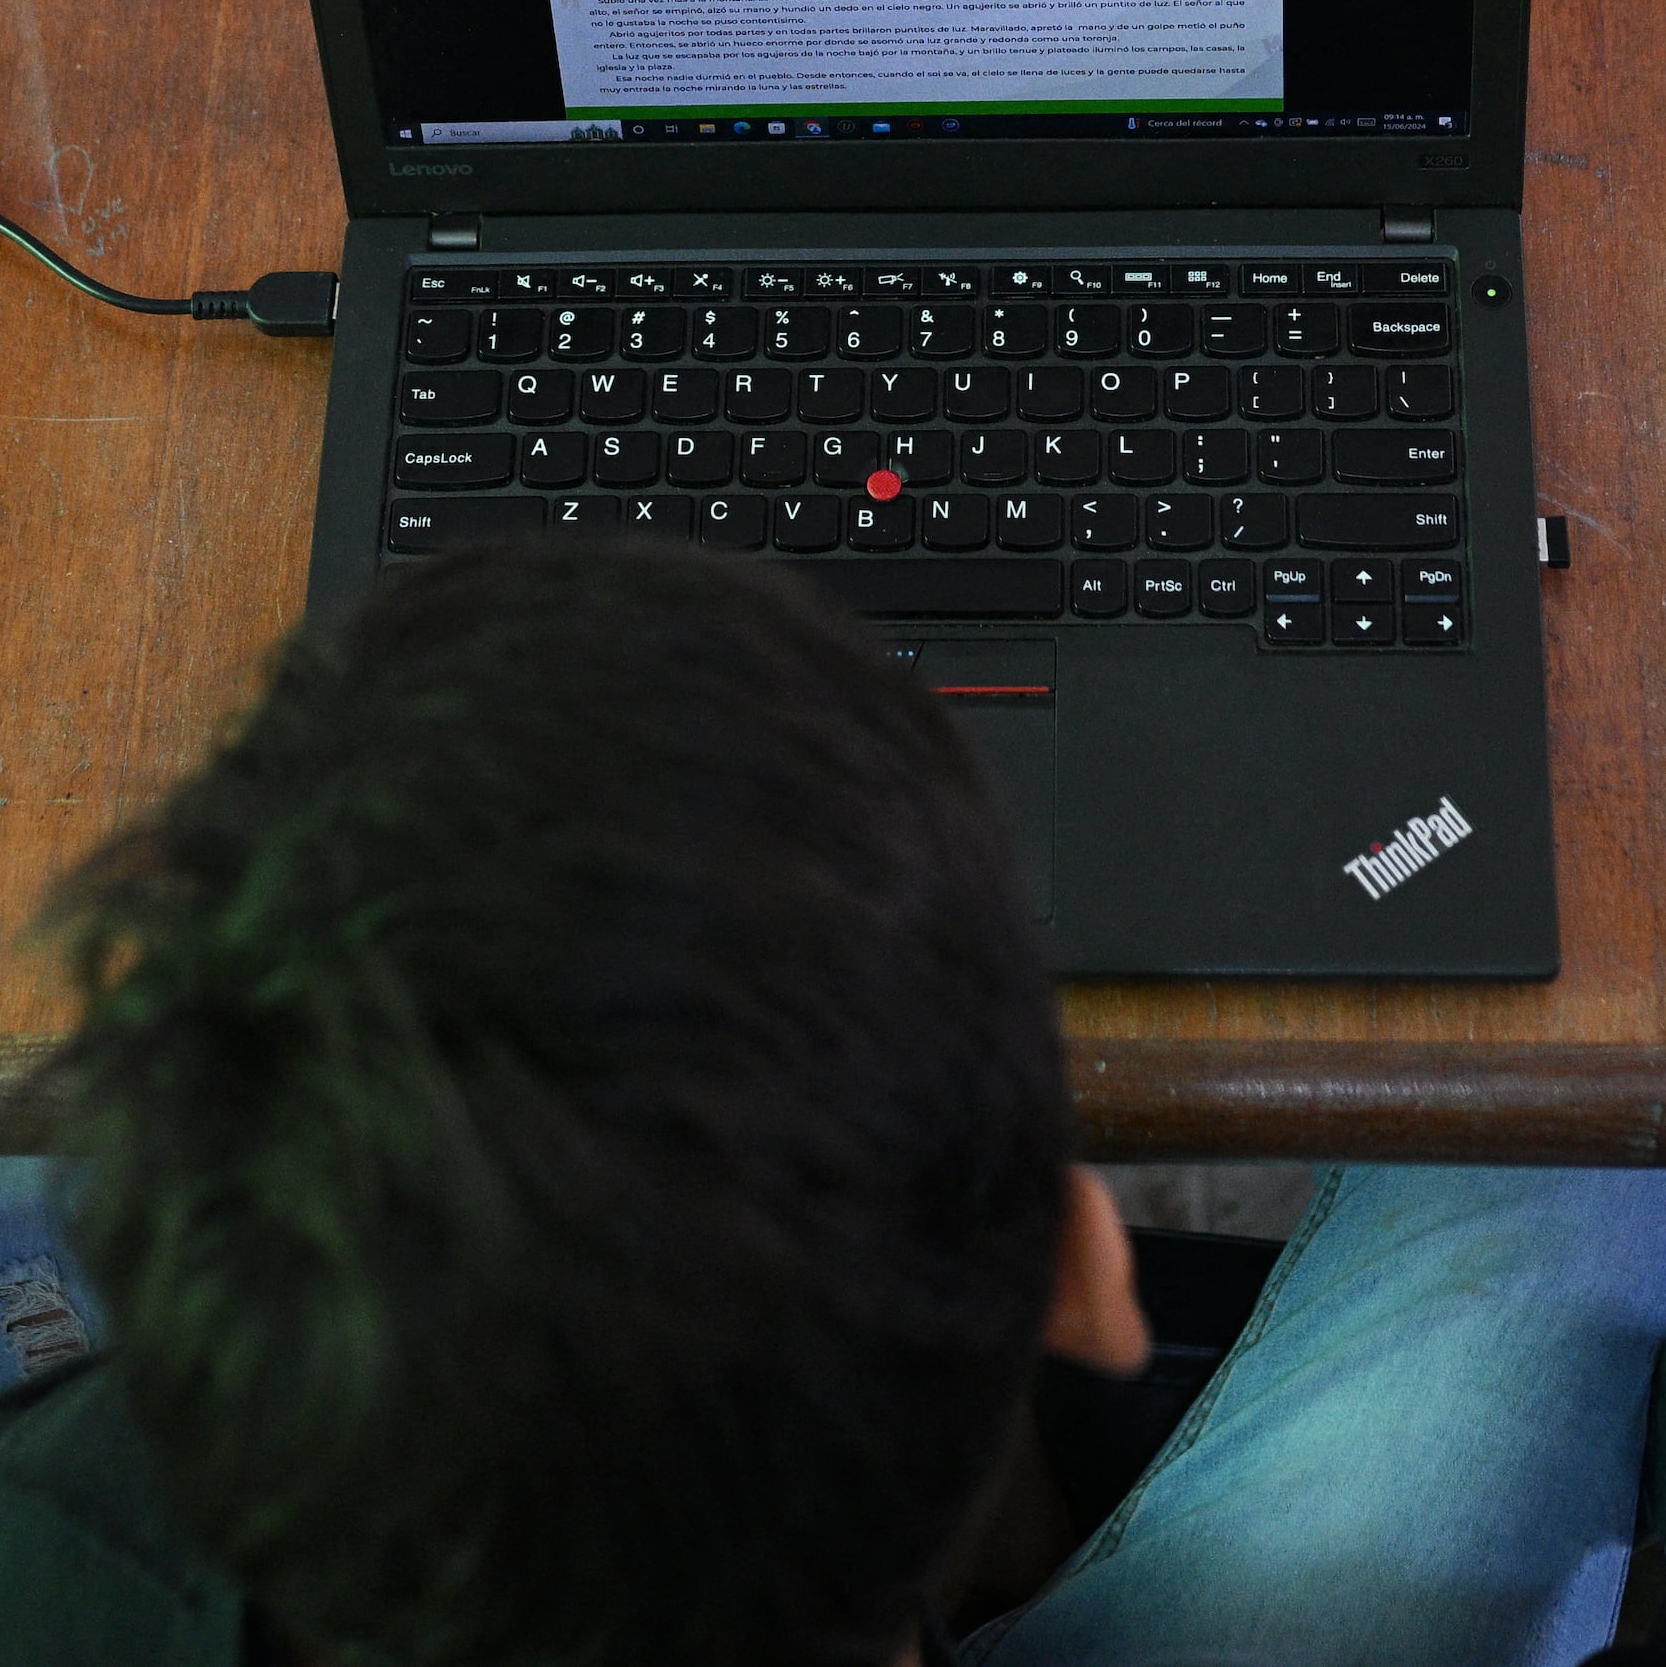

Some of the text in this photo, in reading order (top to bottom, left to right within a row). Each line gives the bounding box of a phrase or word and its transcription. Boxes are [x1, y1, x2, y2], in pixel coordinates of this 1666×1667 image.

[1147, 119, 1173, 127] Cerca
[389, 162, 473, 176] Lenovo
[422, 277, 445, 289] Esc
[1253, 272, 1287, 284] Home
[1317, 271, 1341, 283] End
[1401, 271, 1439, 284] Delete
[1373, 322, 1440, 335] Backspace
[488, 334, 496, 349] 1
[558, 333, 571, 349] 2
[630, 333, 642, 349] 3
[703, 333, 715, 348] 4
[776, 332, 788, 348] 5
[848, 332, 860, 348] 6
[921, 332, 932, 347] 7
[993, 330, 1005, 346] 8
[1066, 330, 1078, 346] 9
[1138, 330, 1151, 346] 0
[518, 376, 537, 394] Q
[592, 375, 615, 392] W
[663, 374, 678, 392] E
[736, 375, 752, 392] R
[809, 375, 824, 392] T
[882, 374, 898, 391] Y
[955, 373, 970, 391] U
[1101, 373, 1120, 390] O
[1175, 373, 1190, 390] P
[411, 389, 435, 400] Tab
[531, 438, 548, 456] A
[604, 437, 619, 455] S
[678, 438, 694, 455] D
[751, 438, 765, 455] F
[824, 437, 841, 455] G
[897, 437, 913, 454] H
[972, 436, 984, 454] J
[1046, 436, 1061, 454] K
[1120, 436, 1133, 453] L
[405, 452, 472, 467] CapsLock
[1409, 447, 1445, 460] Enter
[562, 502, 579, 520] Z
[636, 502, 652, 520] X
[711, 501, 728, 520] C
[785, 502, 801, 519] V
[933, 501, 949, 518] N
[1007, 500, 1026, 518] M
[399, 516, 431, 528] Shift
[858, 510, 873, 527] B
[1416, 513, 1447, 525] Shift
[1274, 571, 1306, 584] PgUp
[1420, 571, 1452, 584] PgDn
[1083, 580, 1101, 592] Alt
[1145, 580, 1182, 592] PrtSc
[1211, 580, 1235, 592] Ctrl
[1342, 795, 1473, 901] ThinkPad
